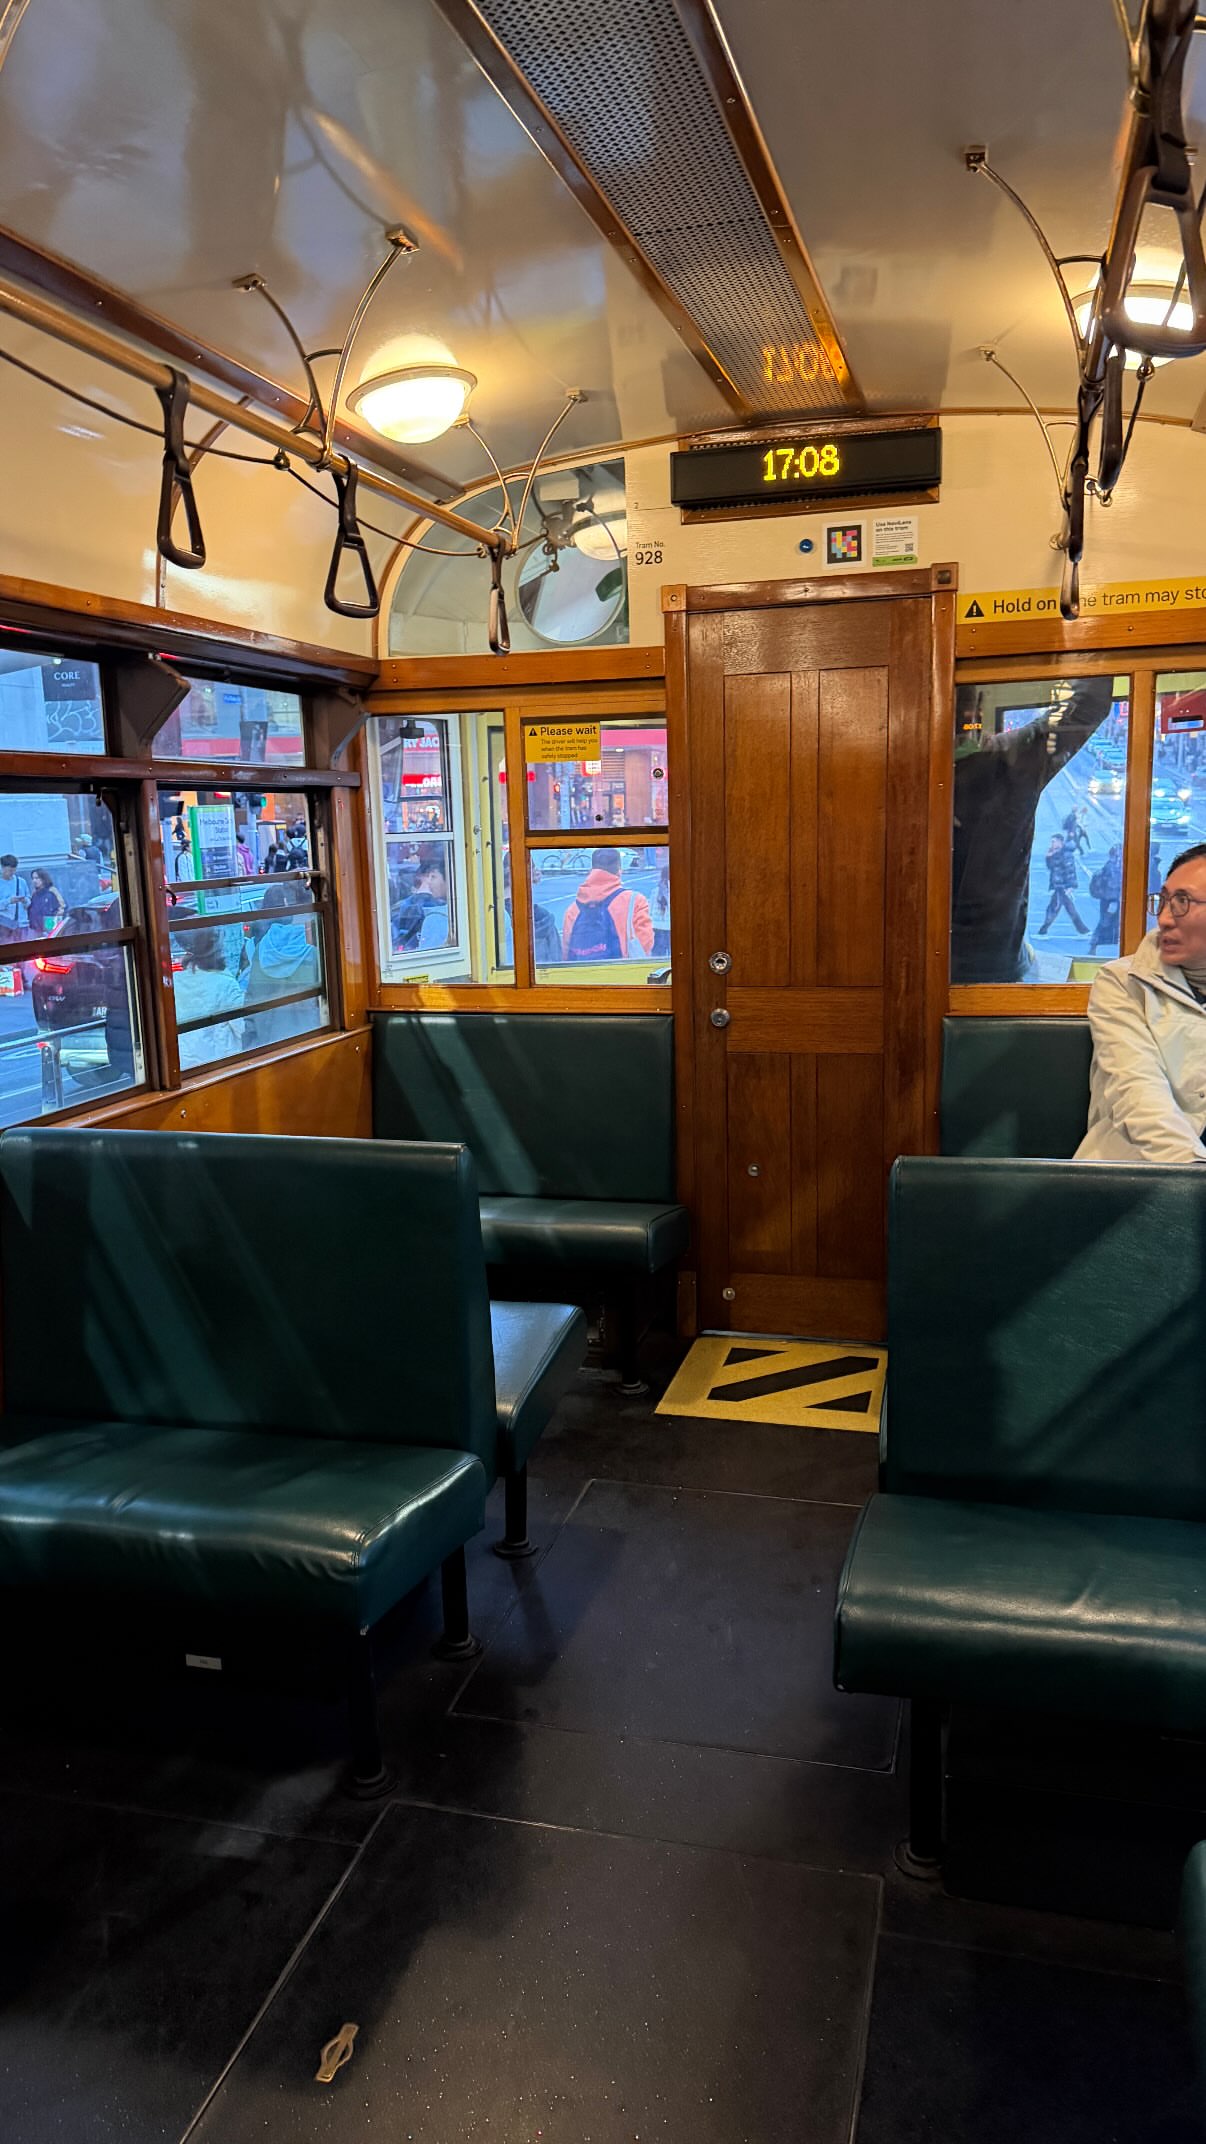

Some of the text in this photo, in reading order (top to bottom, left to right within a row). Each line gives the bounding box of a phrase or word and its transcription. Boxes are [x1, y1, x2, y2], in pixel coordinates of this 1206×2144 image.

[763, 444, 840, 481] 17:08
[635, 550, 663, 566] 928
[993, 598, 1032, 614] Hold
[1036, 598, 1057, 612] on
[1102, 592, 1141, 607] tram
[1145, 588, 1180, 605] may
[53, 671, 81, 681] CORE
[540, 725, 597, 736] Please wait
